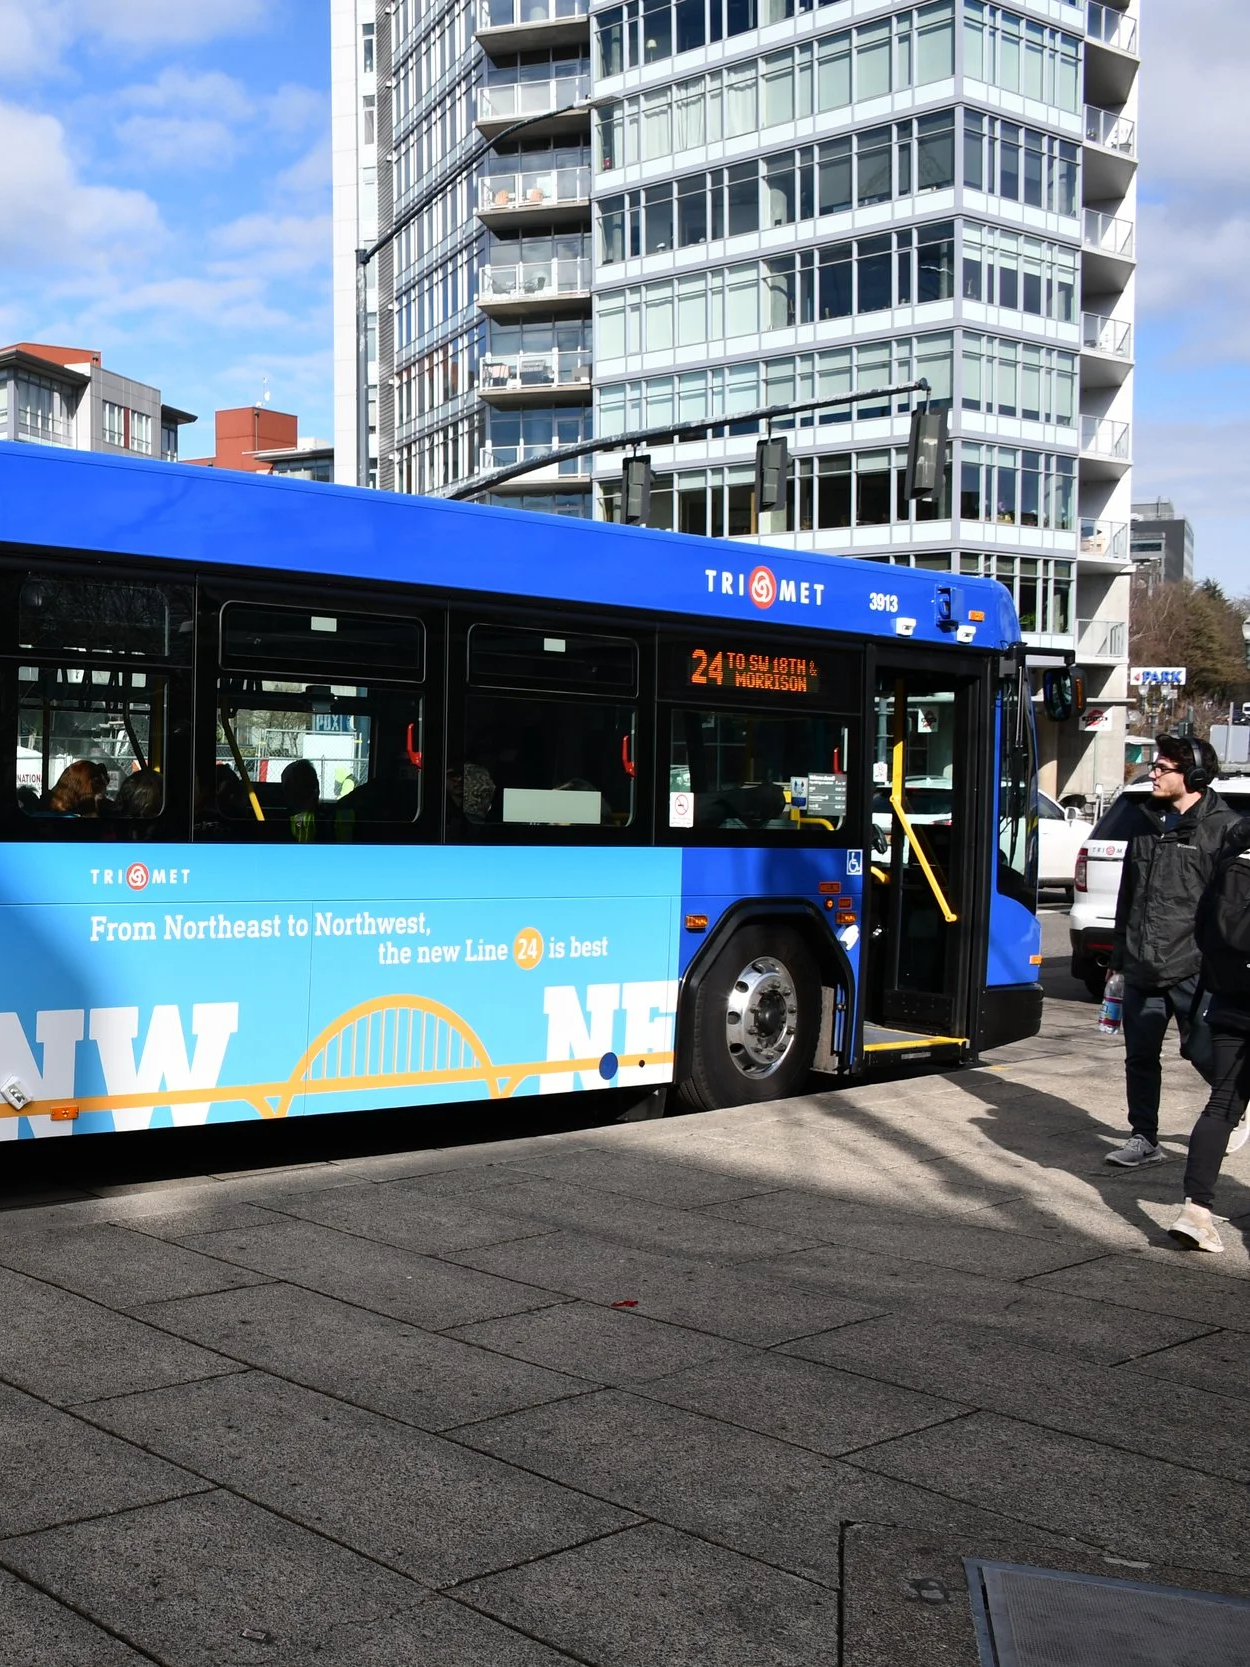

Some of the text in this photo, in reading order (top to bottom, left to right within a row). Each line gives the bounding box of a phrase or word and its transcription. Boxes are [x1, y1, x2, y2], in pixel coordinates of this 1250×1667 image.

[705, 569, 824, 606] TRI MET
[869, 592, 898, 612] 3913
[691, 649, 723, 685] 24
[727, 652, 746, 670] TO
[749, 654, 769, 672] SW
[772, 657, 806, 675] 18TH
[735, 671, 807, 692] MORRISON
[1142, 670, 1183, 684] PARK
[17, 774, 42, 783] NATION
[90, 868, 190, 884] TRI MET
[90, 911, 431, 942] From Northeast to Northwest,
[378, 936, 608, 965] the new Line 24 is best
[538, 979, 679, 1095] NE
